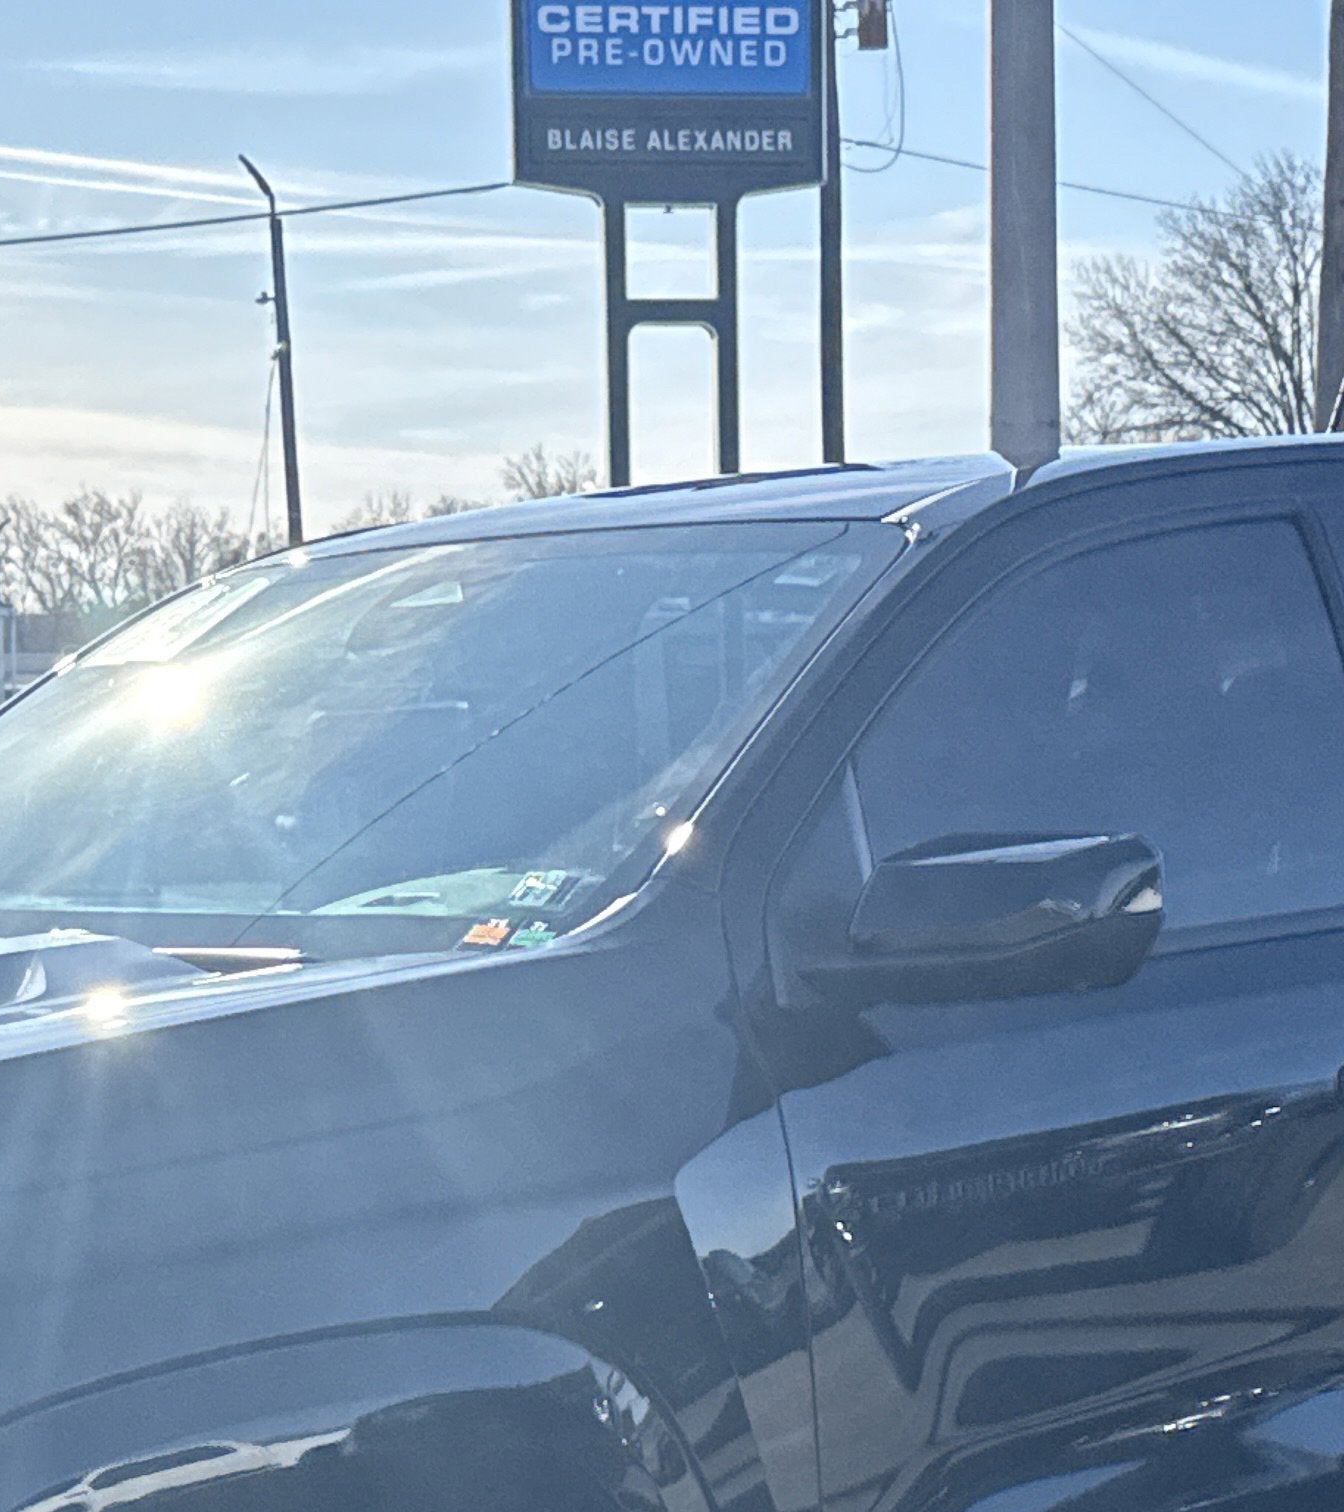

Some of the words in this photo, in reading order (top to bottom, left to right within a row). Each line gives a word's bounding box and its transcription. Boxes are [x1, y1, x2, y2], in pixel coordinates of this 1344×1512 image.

[537, 6, 799, 35] CERTIFIED
[552, 38, 786, 67] PRE-OWNED
[547, 129, 636, 151] BLAISE
[647, 129, 792, 151] ALEXANDER
